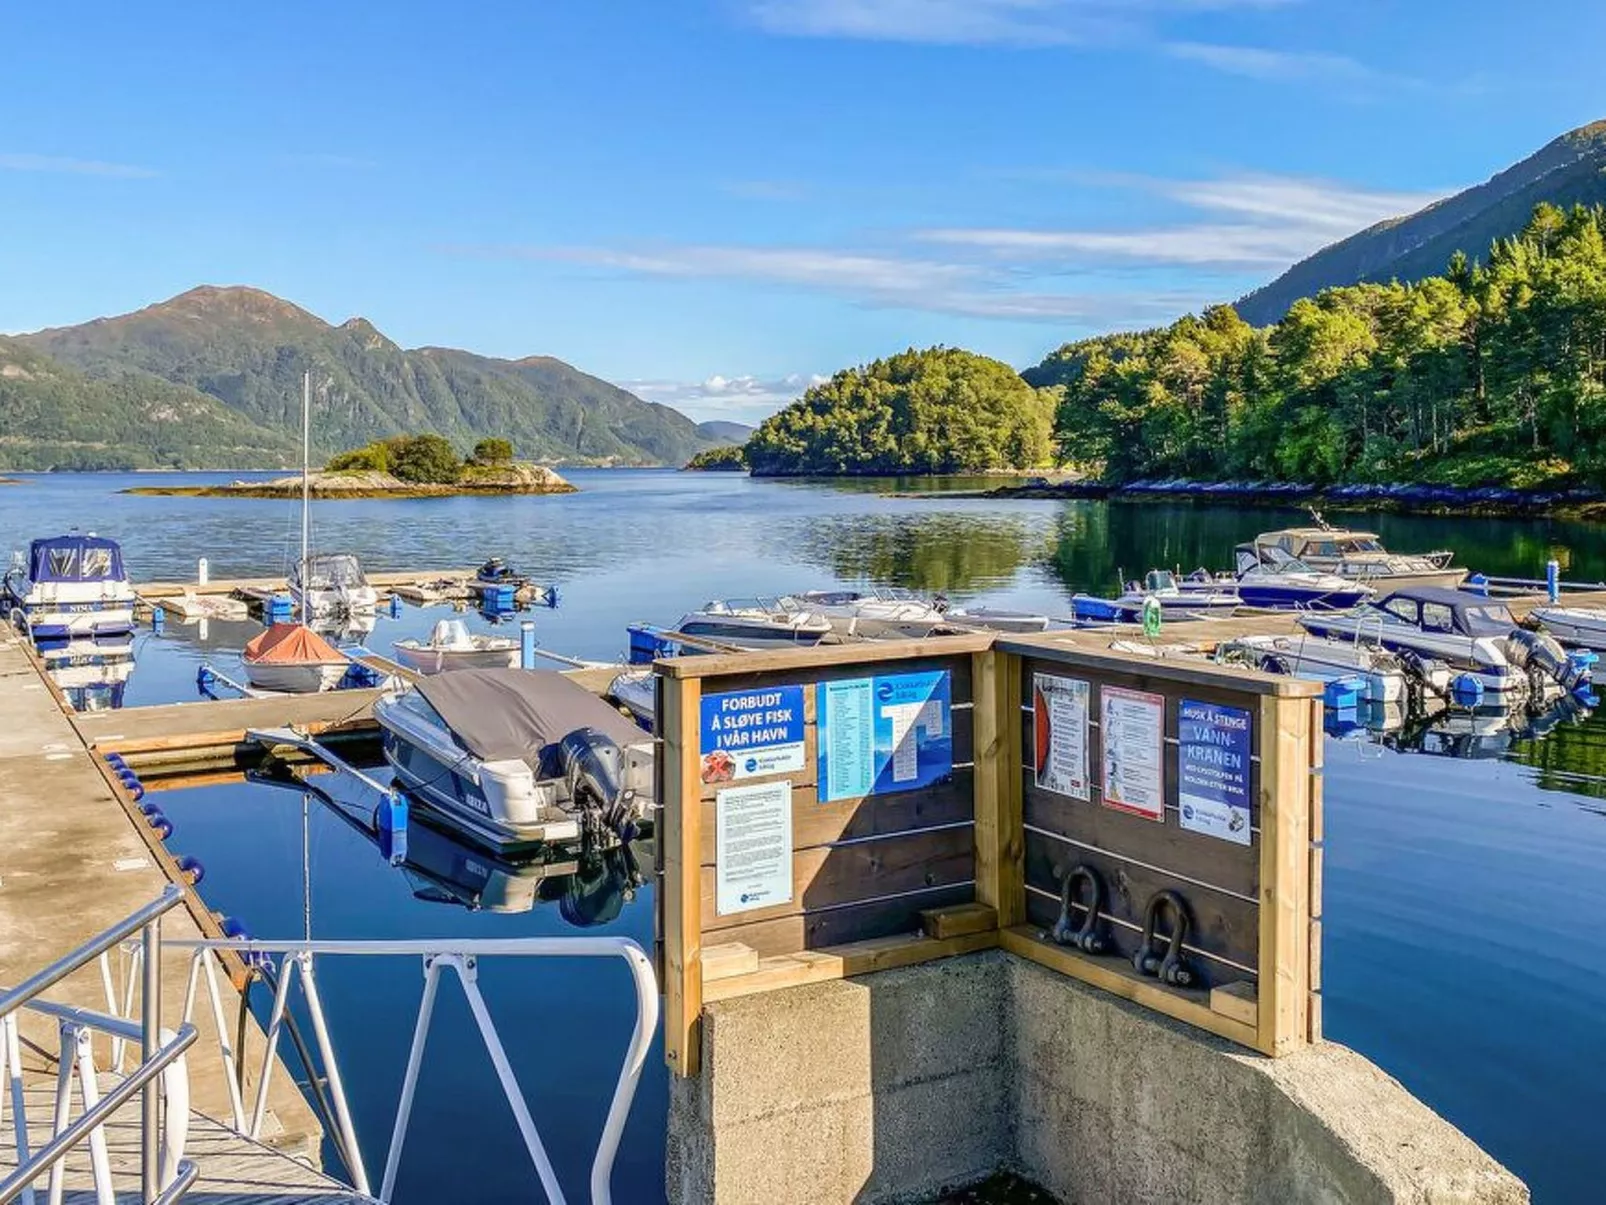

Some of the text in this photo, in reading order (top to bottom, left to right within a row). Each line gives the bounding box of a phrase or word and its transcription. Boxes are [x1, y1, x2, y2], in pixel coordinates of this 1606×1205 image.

[722, 692, 782, 712] FORBUDT
[711, 709, 792, 731] Å SLØYE FISK
[1184, 708, 1246, 730] HUSK Å STENGE
[717, 727, 788, 747] I VÅR HAVN
[1193, 726, 1236, 747] VANN-
[1187, 745, 1241, 768] KRANEN
